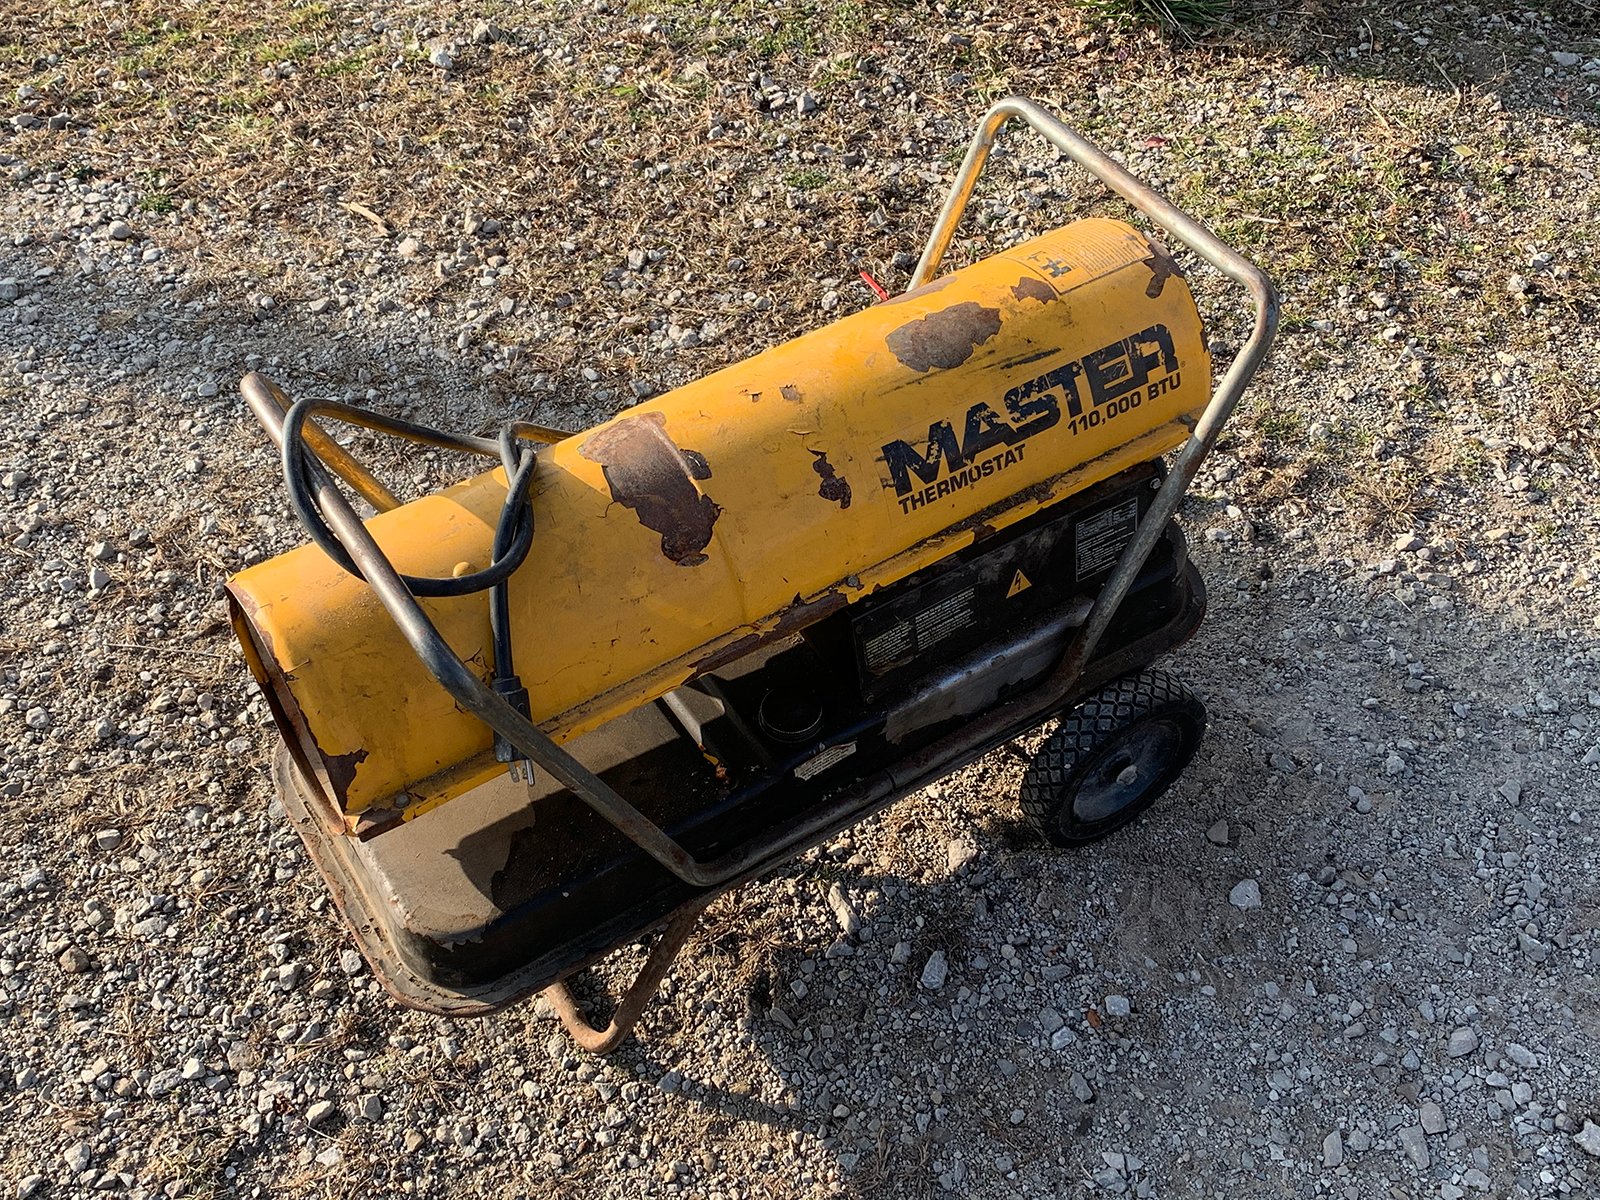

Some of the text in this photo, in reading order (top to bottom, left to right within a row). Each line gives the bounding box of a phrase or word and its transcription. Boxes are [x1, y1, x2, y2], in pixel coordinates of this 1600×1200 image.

[881, 323, 1179, 497] MASTER
[1067, 372, 1182, 436] 110,000 BTU
[898, 443, 1025, 515] THERMOSTAT
